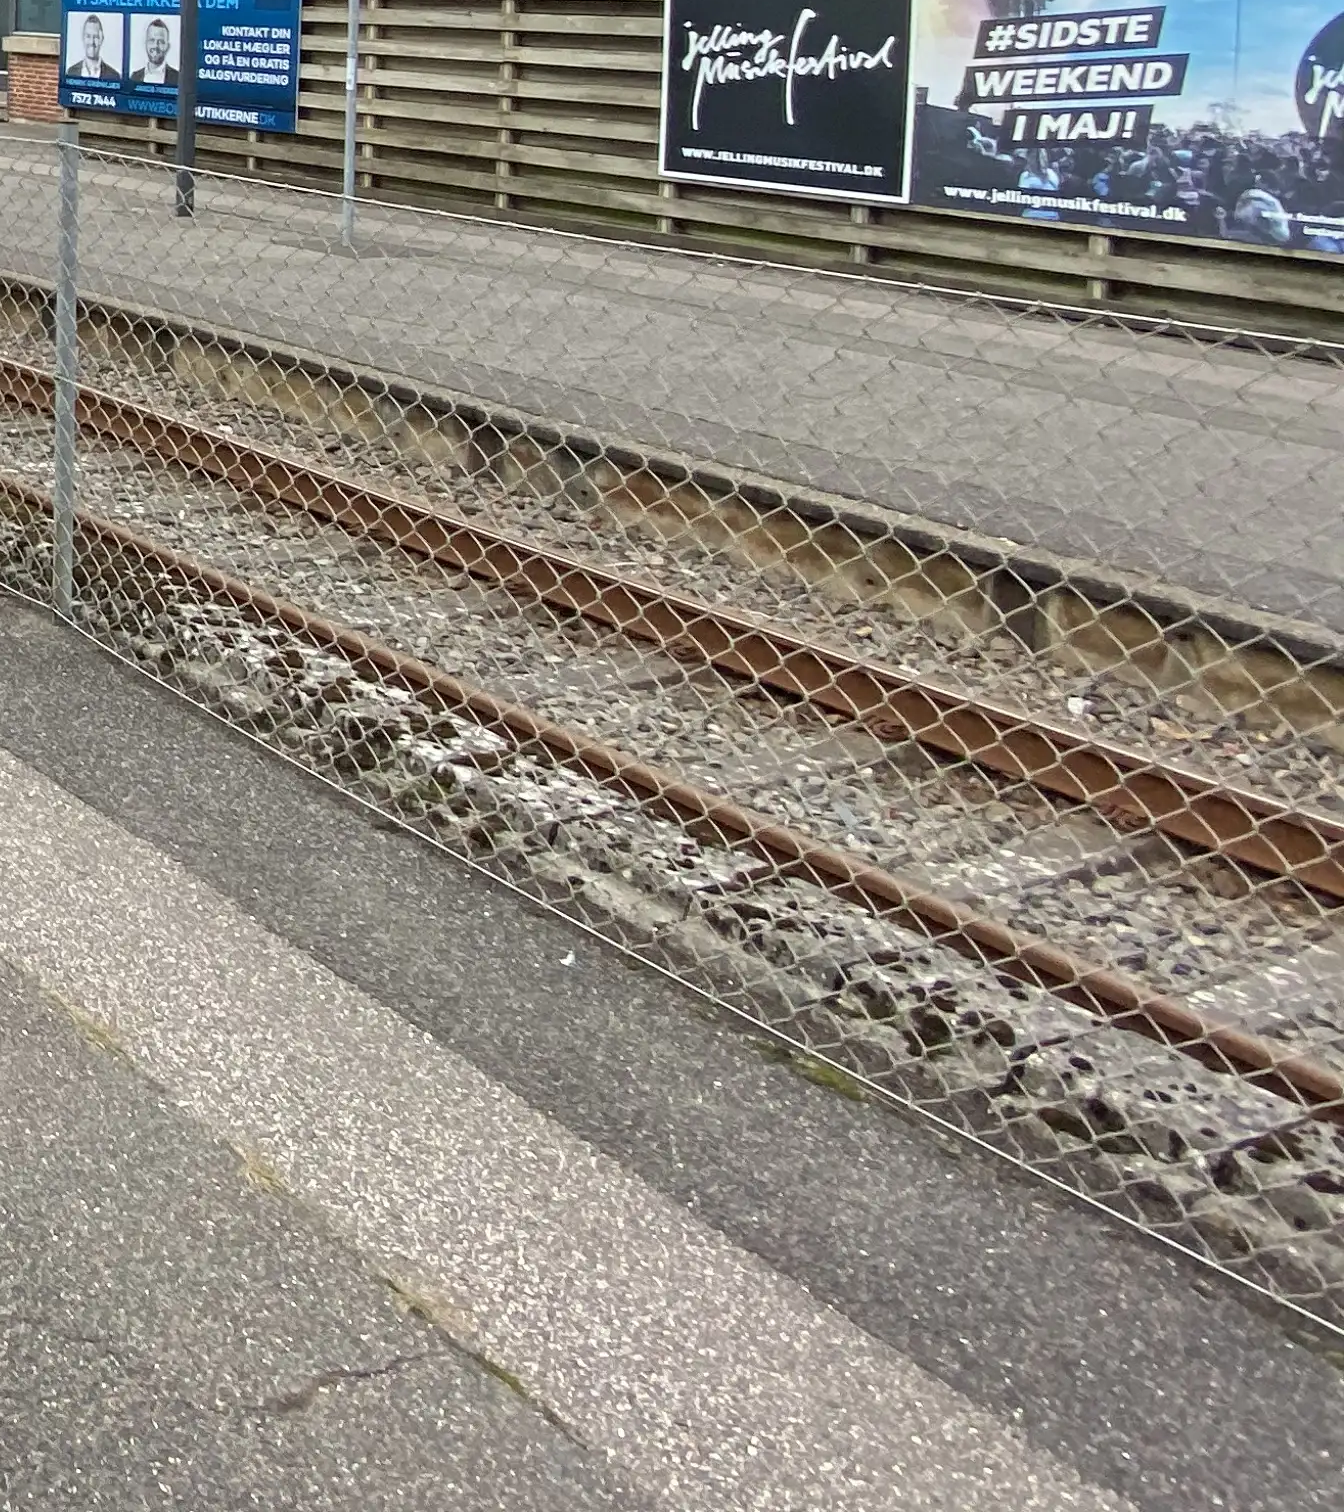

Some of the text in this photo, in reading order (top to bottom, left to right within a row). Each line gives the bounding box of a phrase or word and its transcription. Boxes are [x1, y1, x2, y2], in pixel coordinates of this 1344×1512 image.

[203, 39, 290, 55] LOKALE MÆGLER
[221, 25, 291, 39] KONTAKT DIN
[984, 14, 1154, 52] #SIDSTE
[198, 67, 289, 86] SALGSVURDERING
[204, 53, 290, 71] OG FÅ EN GRATIS
[974, 62, 1174, 98] WEEKEND
[1012, 111, 1138, 141] I MAJ!
[680, 146, 885, 178] WWW.JELLINGMUSIKFESTIVAL.DK
[943, 184, 1188, 223] www.jellingmusikfestival.dk
